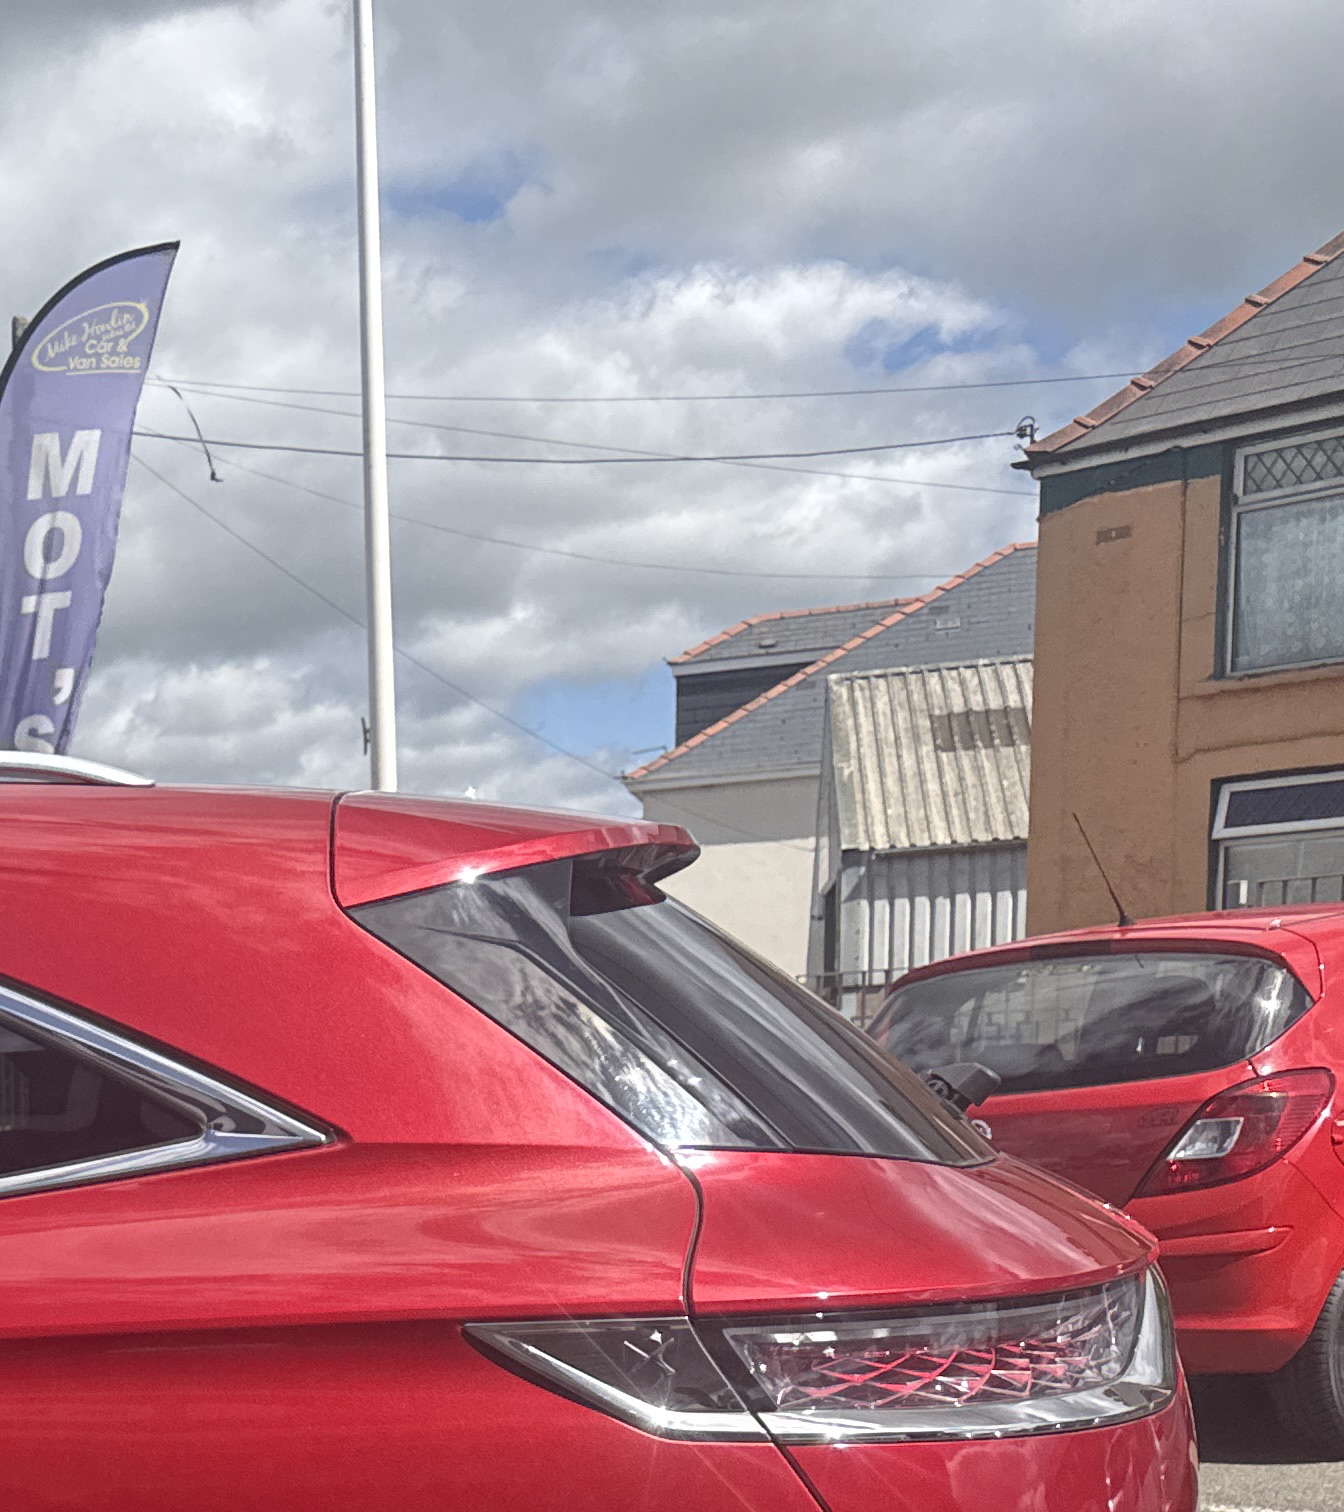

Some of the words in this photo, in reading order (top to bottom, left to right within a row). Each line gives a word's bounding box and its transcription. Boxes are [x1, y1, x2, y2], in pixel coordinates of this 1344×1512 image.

[85, 340, 114, 355] Car
[117, 338, 128, 352] &
[68, 356, 97, 370] Van
[100, 354, 141, 369] Sales
